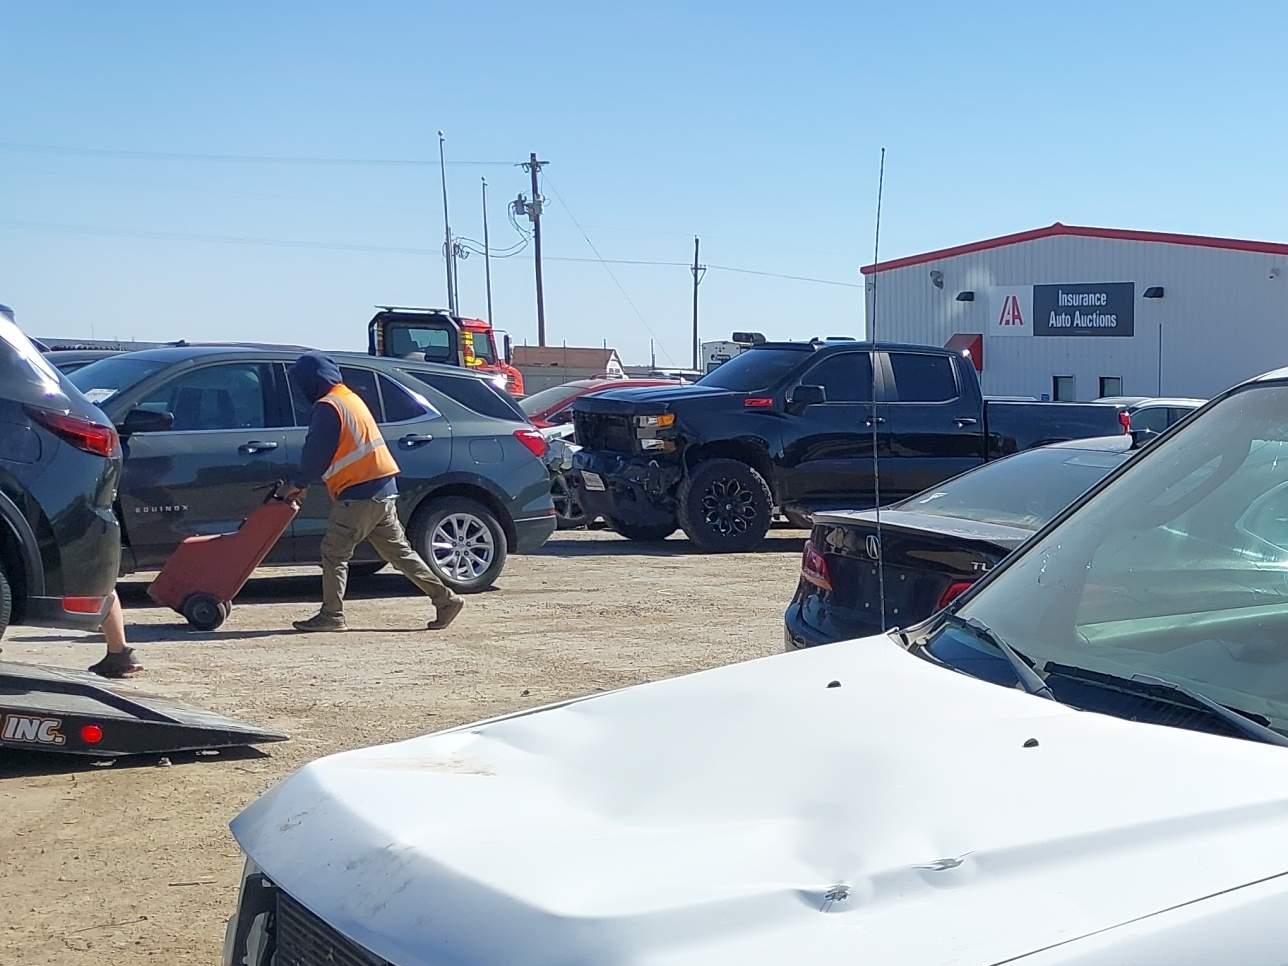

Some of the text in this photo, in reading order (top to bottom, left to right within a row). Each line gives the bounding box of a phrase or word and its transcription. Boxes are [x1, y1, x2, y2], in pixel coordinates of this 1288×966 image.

[1058, 290, 1107, 306] Insurance
[1049, 310, 1117, 327] Auto Auctions
[135, 505, 189, 513] EQUINOX
[2, 714, 66, 745] INC.
